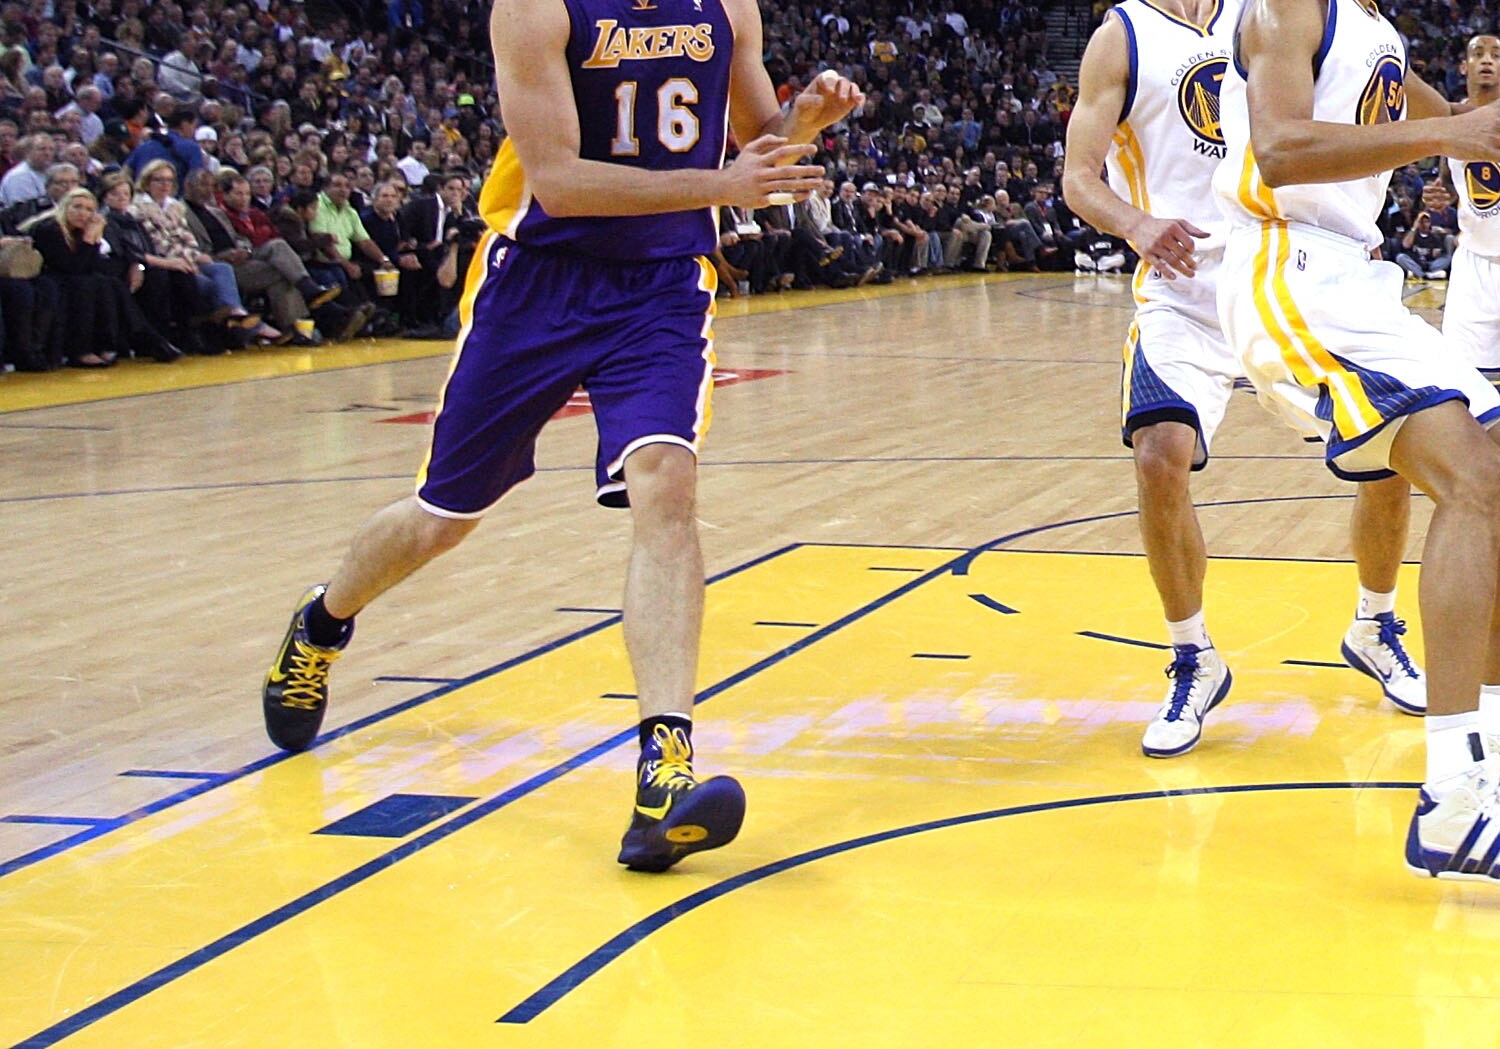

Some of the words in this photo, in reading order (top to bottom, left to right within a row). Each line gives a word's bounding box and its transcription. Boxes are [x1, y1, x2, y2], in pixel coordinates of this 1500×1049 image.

[581, 19, 715, 69] LAKERS
[1366, 43, 1397, 68] GOLDEN
[1170, 50, 1214, 86] GOLDEN
[1387, 80, 1403, 110] 50
[611, 78, 700, 156] 16
[1481, 166, 1491, 180] 8
